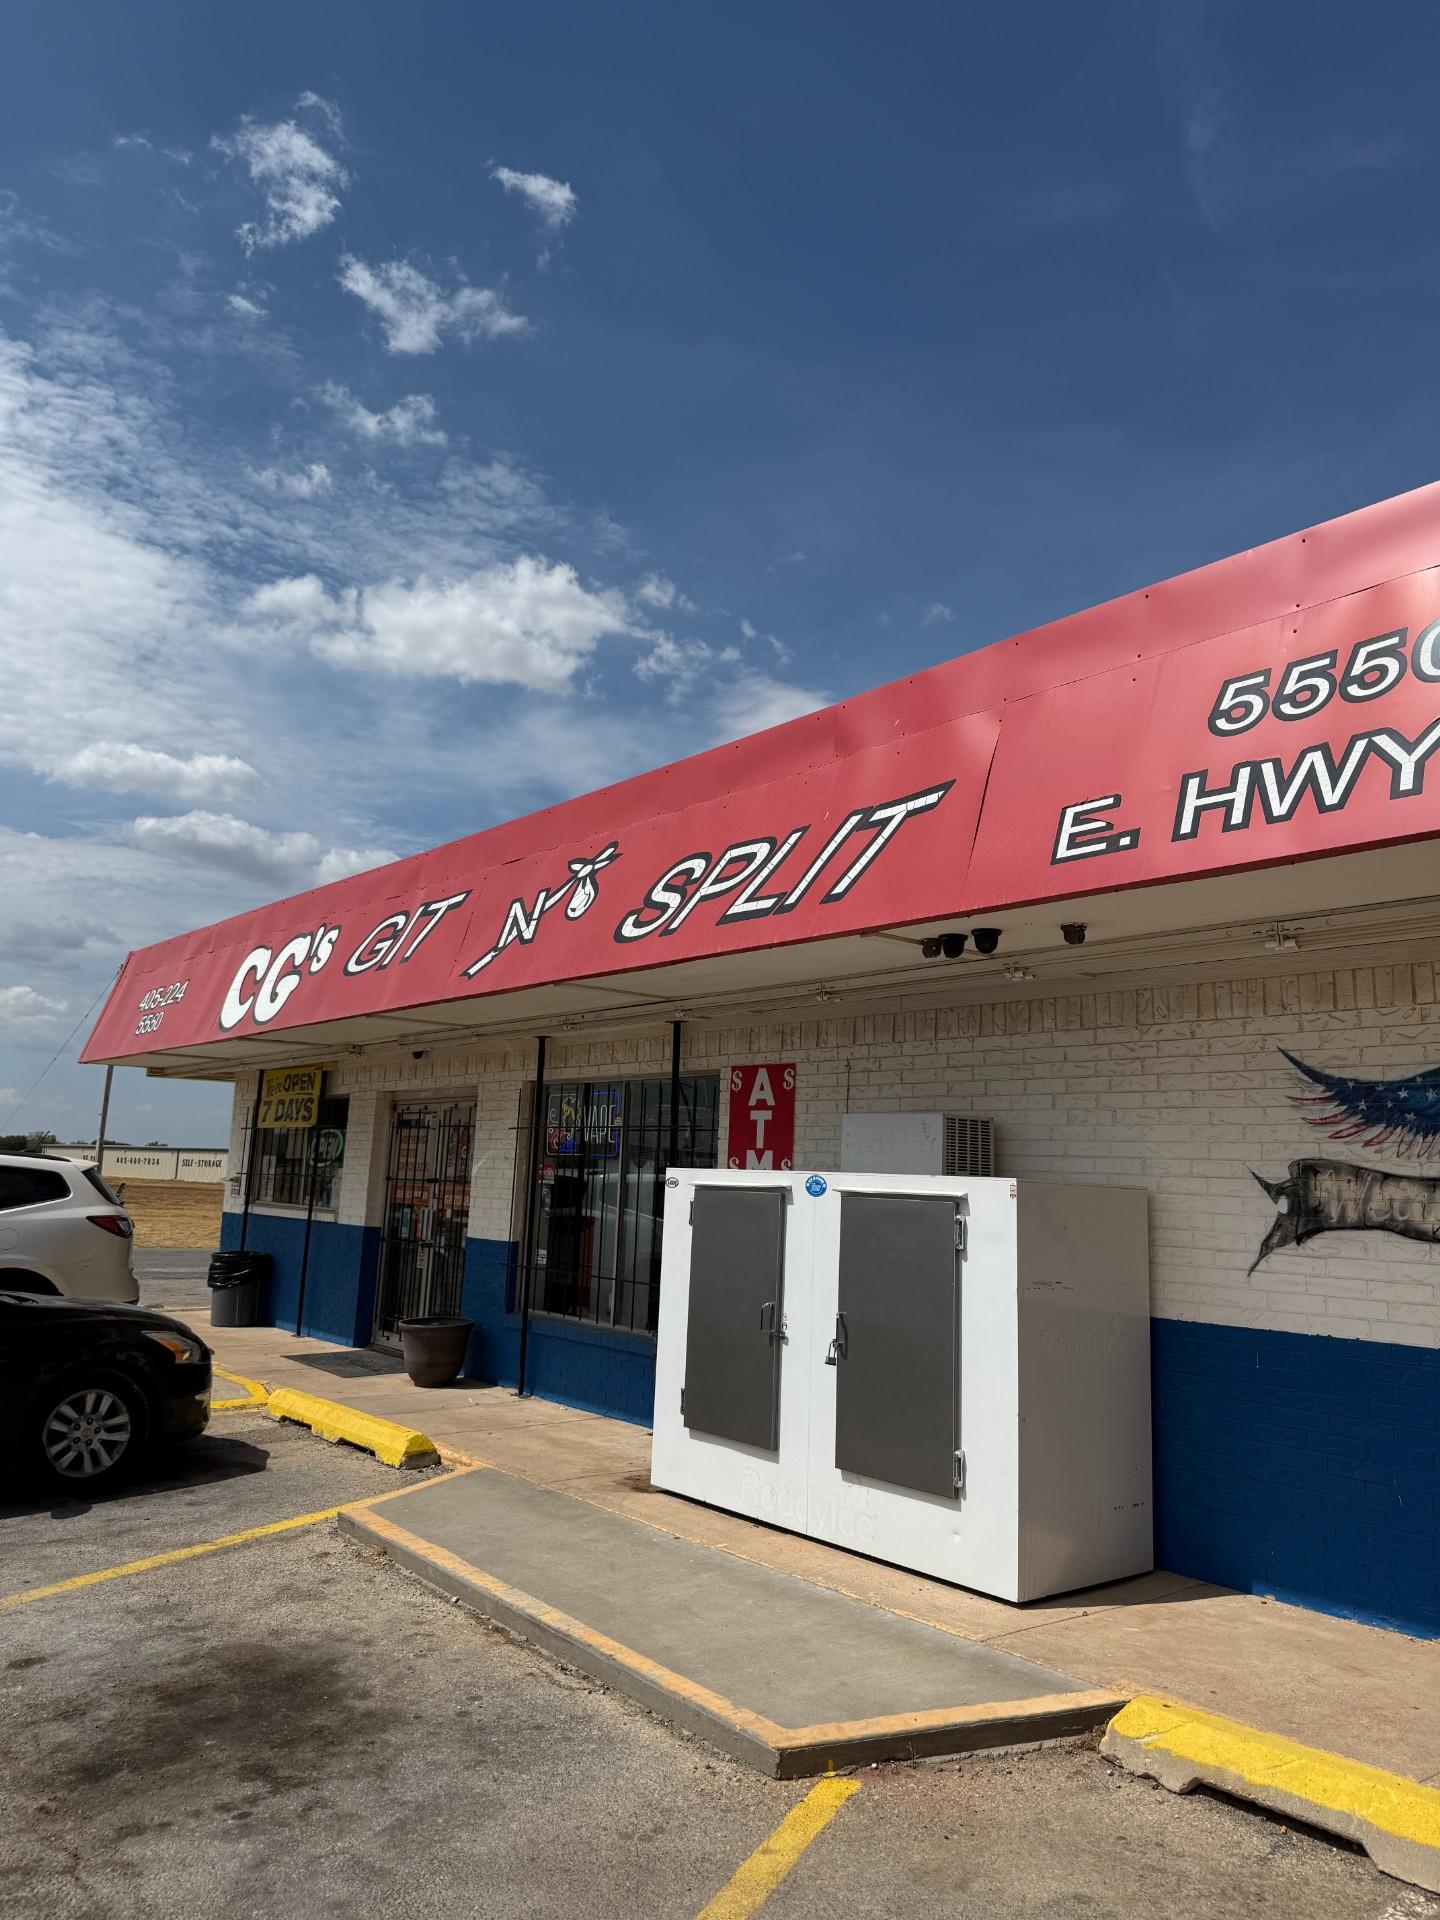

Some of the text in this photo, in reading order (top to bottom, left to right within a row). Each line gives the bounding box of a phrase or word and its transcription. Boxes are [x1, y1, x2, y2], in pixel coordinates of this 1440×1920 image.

[1051, 717, 1440, 865] E. HWY
[218, 924, 341, 1031] CG's
[344, 890, 472, 976] GIT
[613, 779, 956, 943] SPLIT
[139, 979, 190, 1012] 405-224
[283, 1072, 316, 1092] OPEN
[262, 1097, 315, 1122] 7 DAYS
[583, 1104, 616, 1144] VAPE
